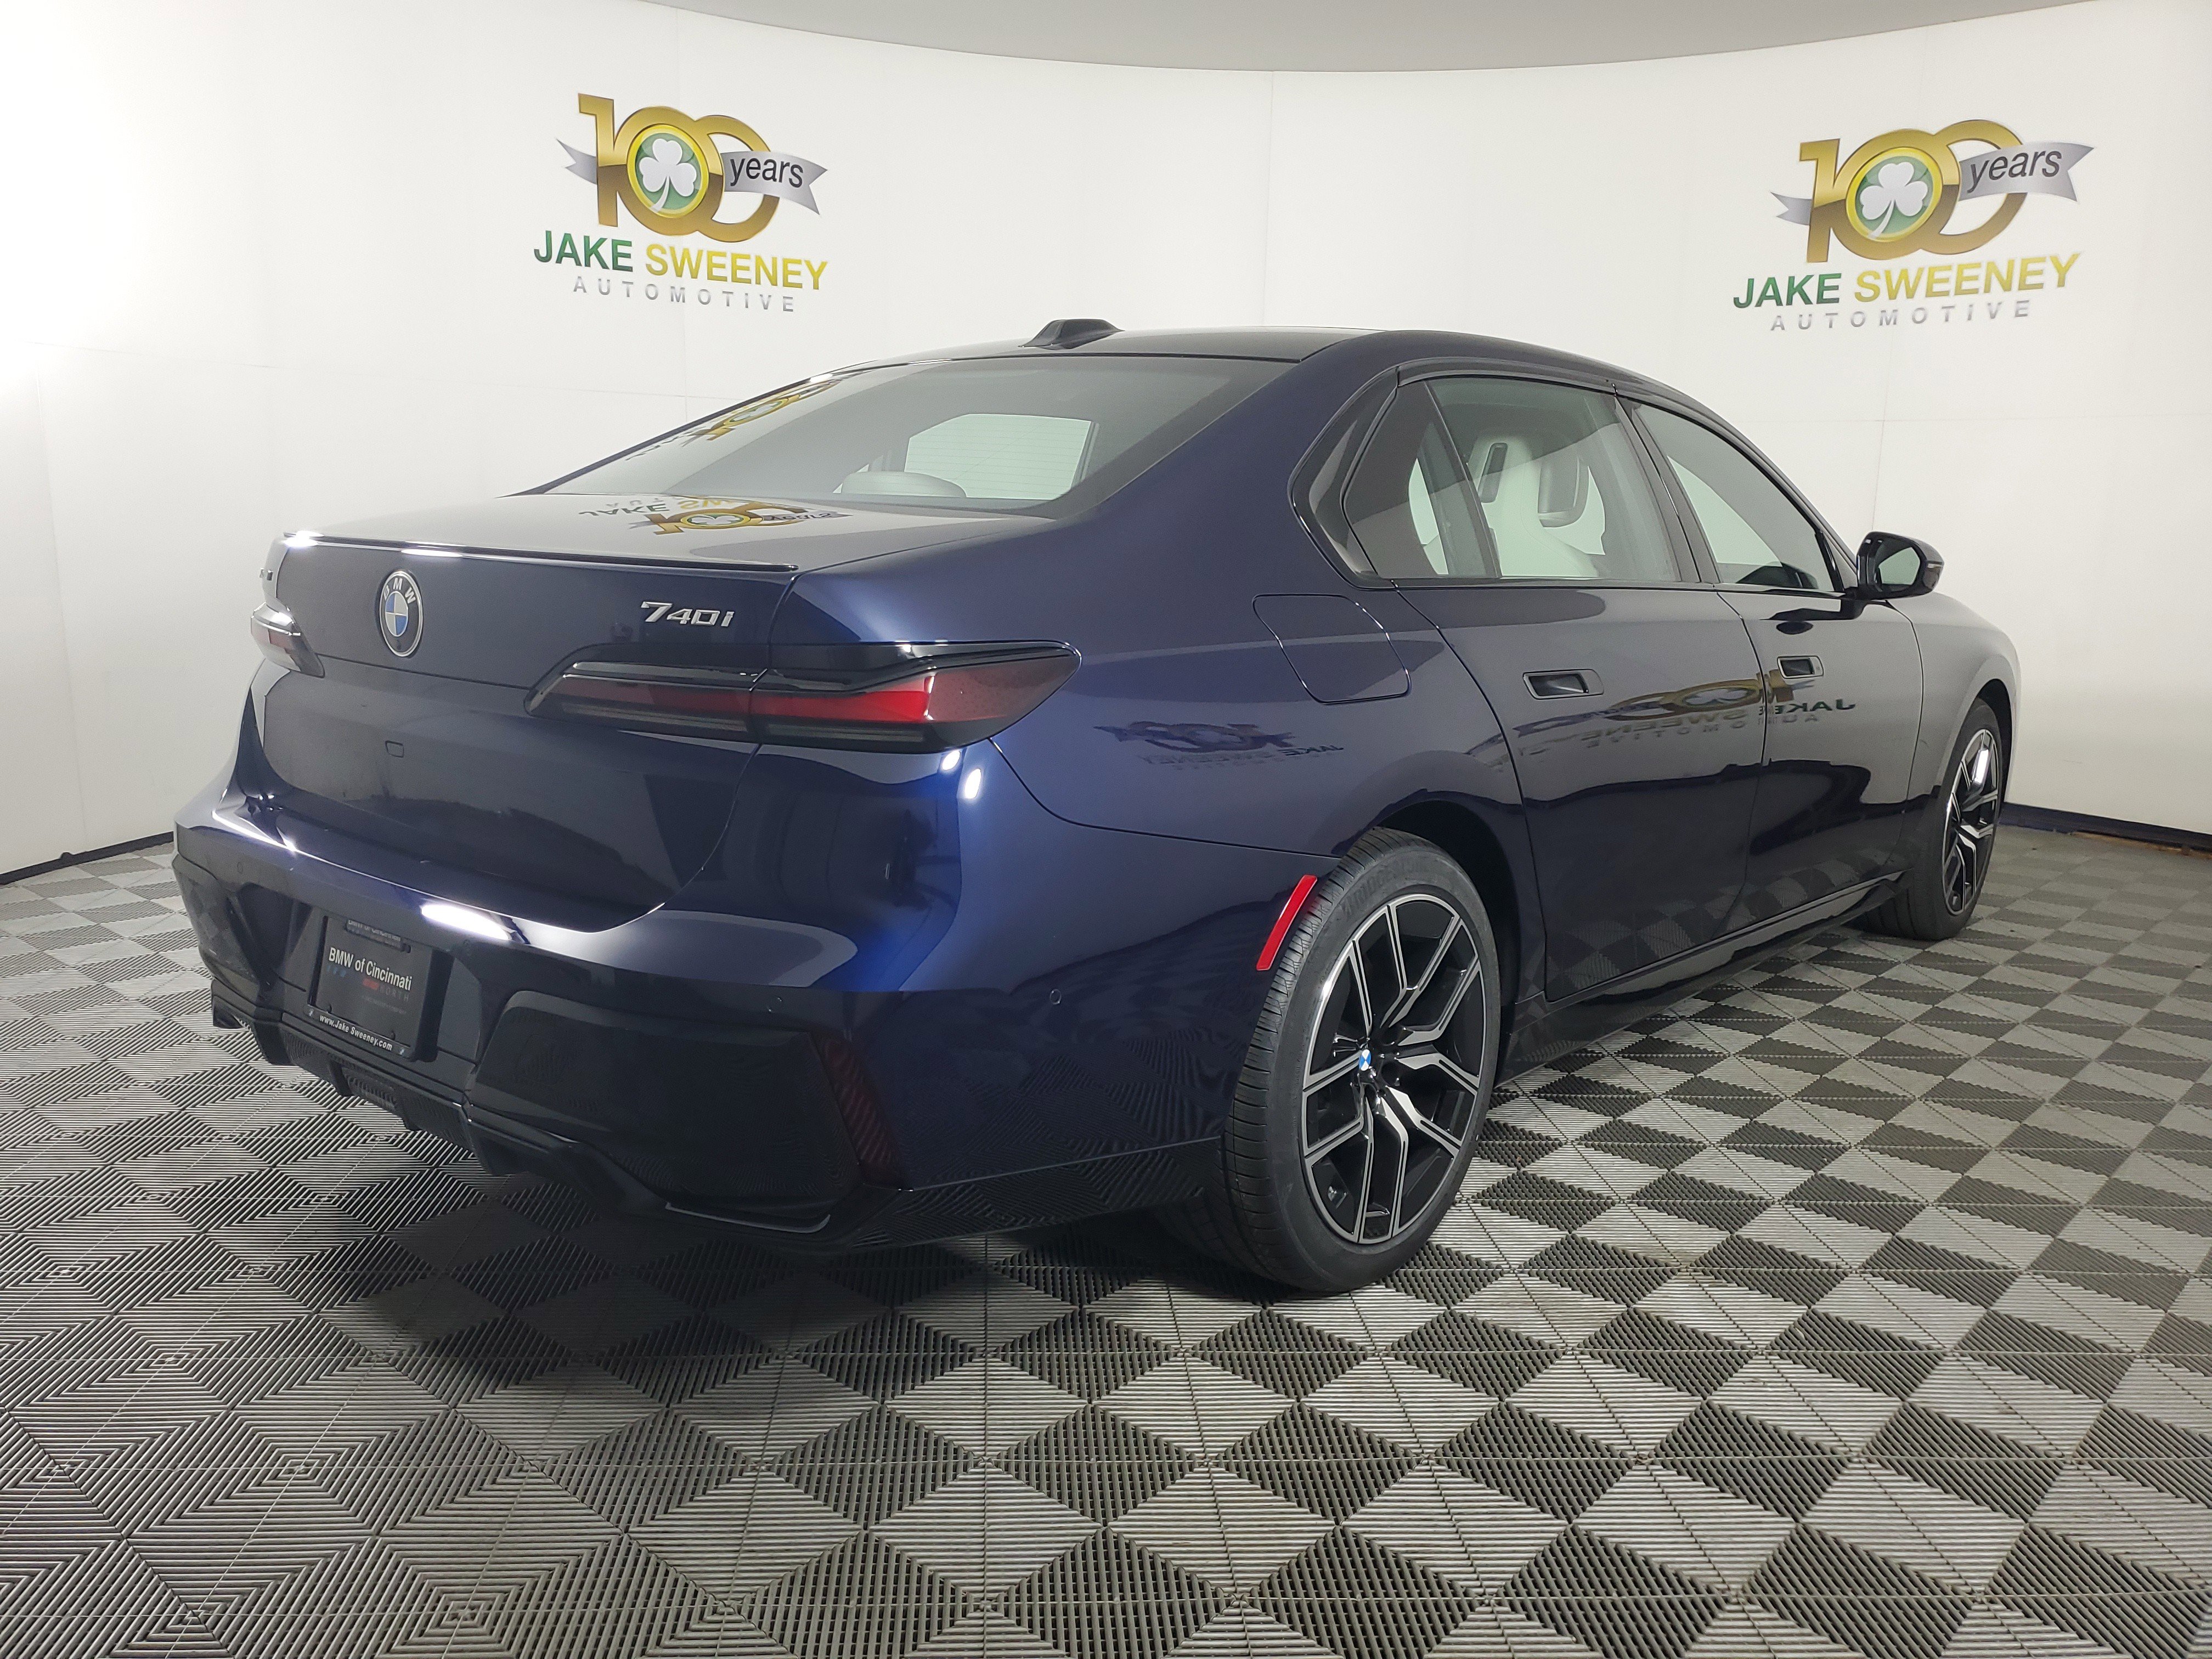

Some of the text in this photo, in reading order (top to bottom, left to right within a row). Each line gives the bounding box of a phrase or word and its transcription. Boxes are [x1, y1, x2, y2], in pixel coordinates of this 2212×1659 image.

[578, 93, 804, 243] 100 years
[1799, 119, 2063, 263] 100 years
[534, 230, 828, 290] JAKE SWEENEY
[573, 276, 794, 312] AUTOMOTIVE
[1733, 252, 2082, 309] JAKE SWEENEY
[1770, 300, 2030, 331] AUTOMOTIVE
[383, 577, 416, 605] BMW
[641, 601, 735, 627] 740i
[329, 947, 413, 991] BMW of Cincinnati
[350, 1026, 393, 1051] Sweeney.com
